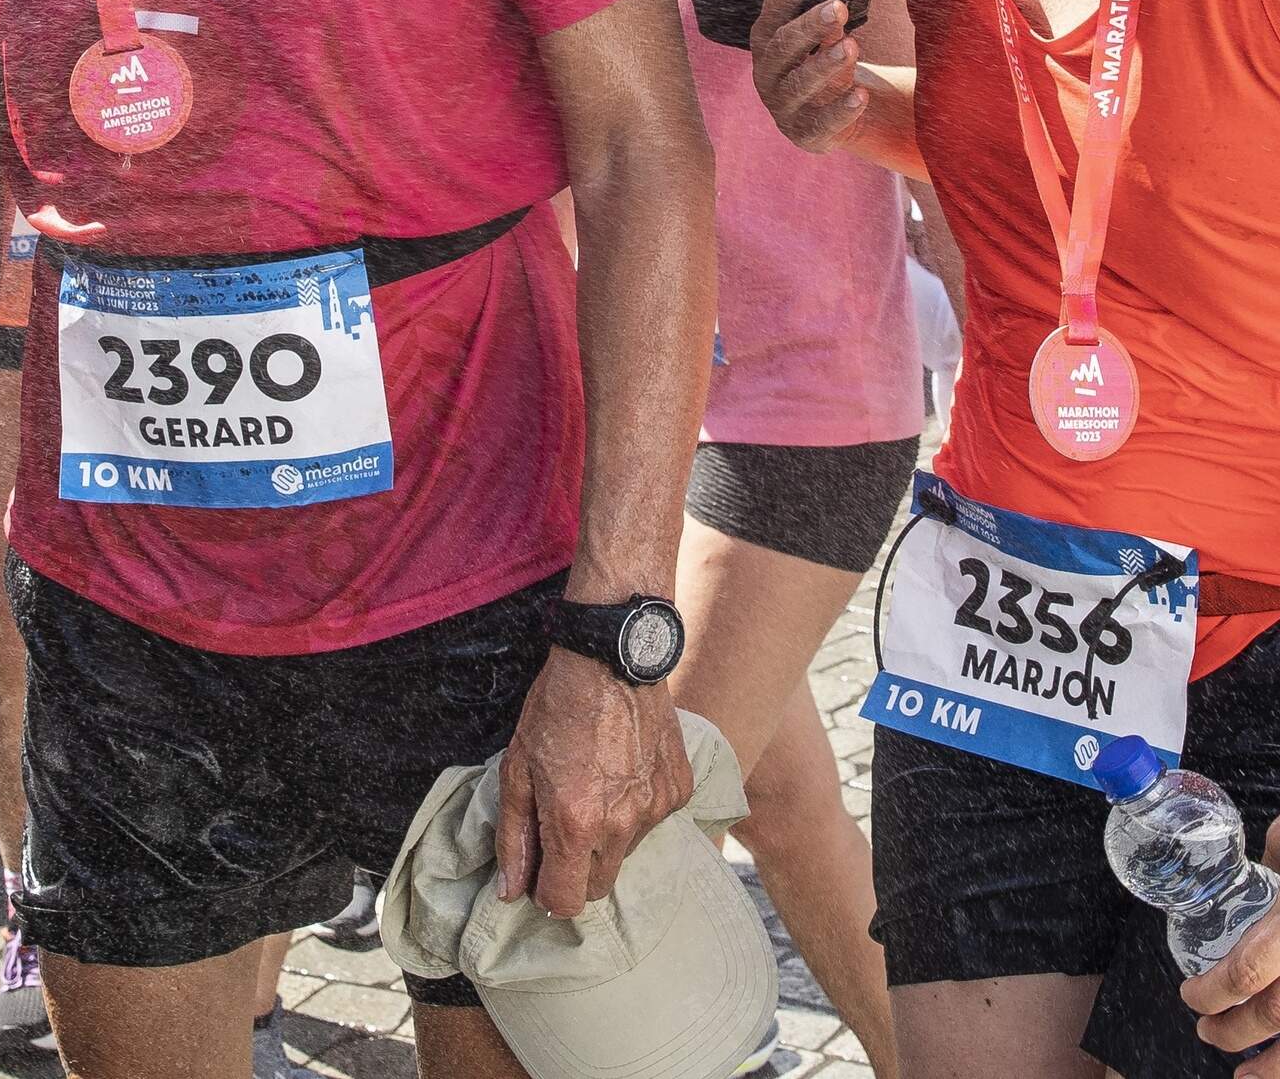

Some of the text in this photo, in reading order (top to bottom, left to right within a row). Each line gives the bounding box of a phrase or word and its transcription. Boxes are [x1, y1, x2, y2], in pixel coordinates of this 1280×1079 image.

[101, 96, 171, 119] MARATHON
[103, 107, 172, 130] AMERSFOORT
[124, 122, 153, 137] 2023
[106, 298, 128, 310] JUNI
[131, 301, 159, 311] 2023
[97, 333, 322, 406] 2390
[1058, 407, 1119, 418] MARATHON
[140, 416, 294, 448] GERARD
[1058, 419, 1119, 430] AMERSFOORT
[1075, 431, 1101, 442] 2023
[79, 462, 173, 491] 10 KM
[306, 455, 380, 481] meander
[307, 470, 380, 489] MEDISCH CENTRUM
[954, 557, 1133, 665] 2356
[961, 643, 1116, 717] MARJON
[885, 684, 982, 735] 10 KM
